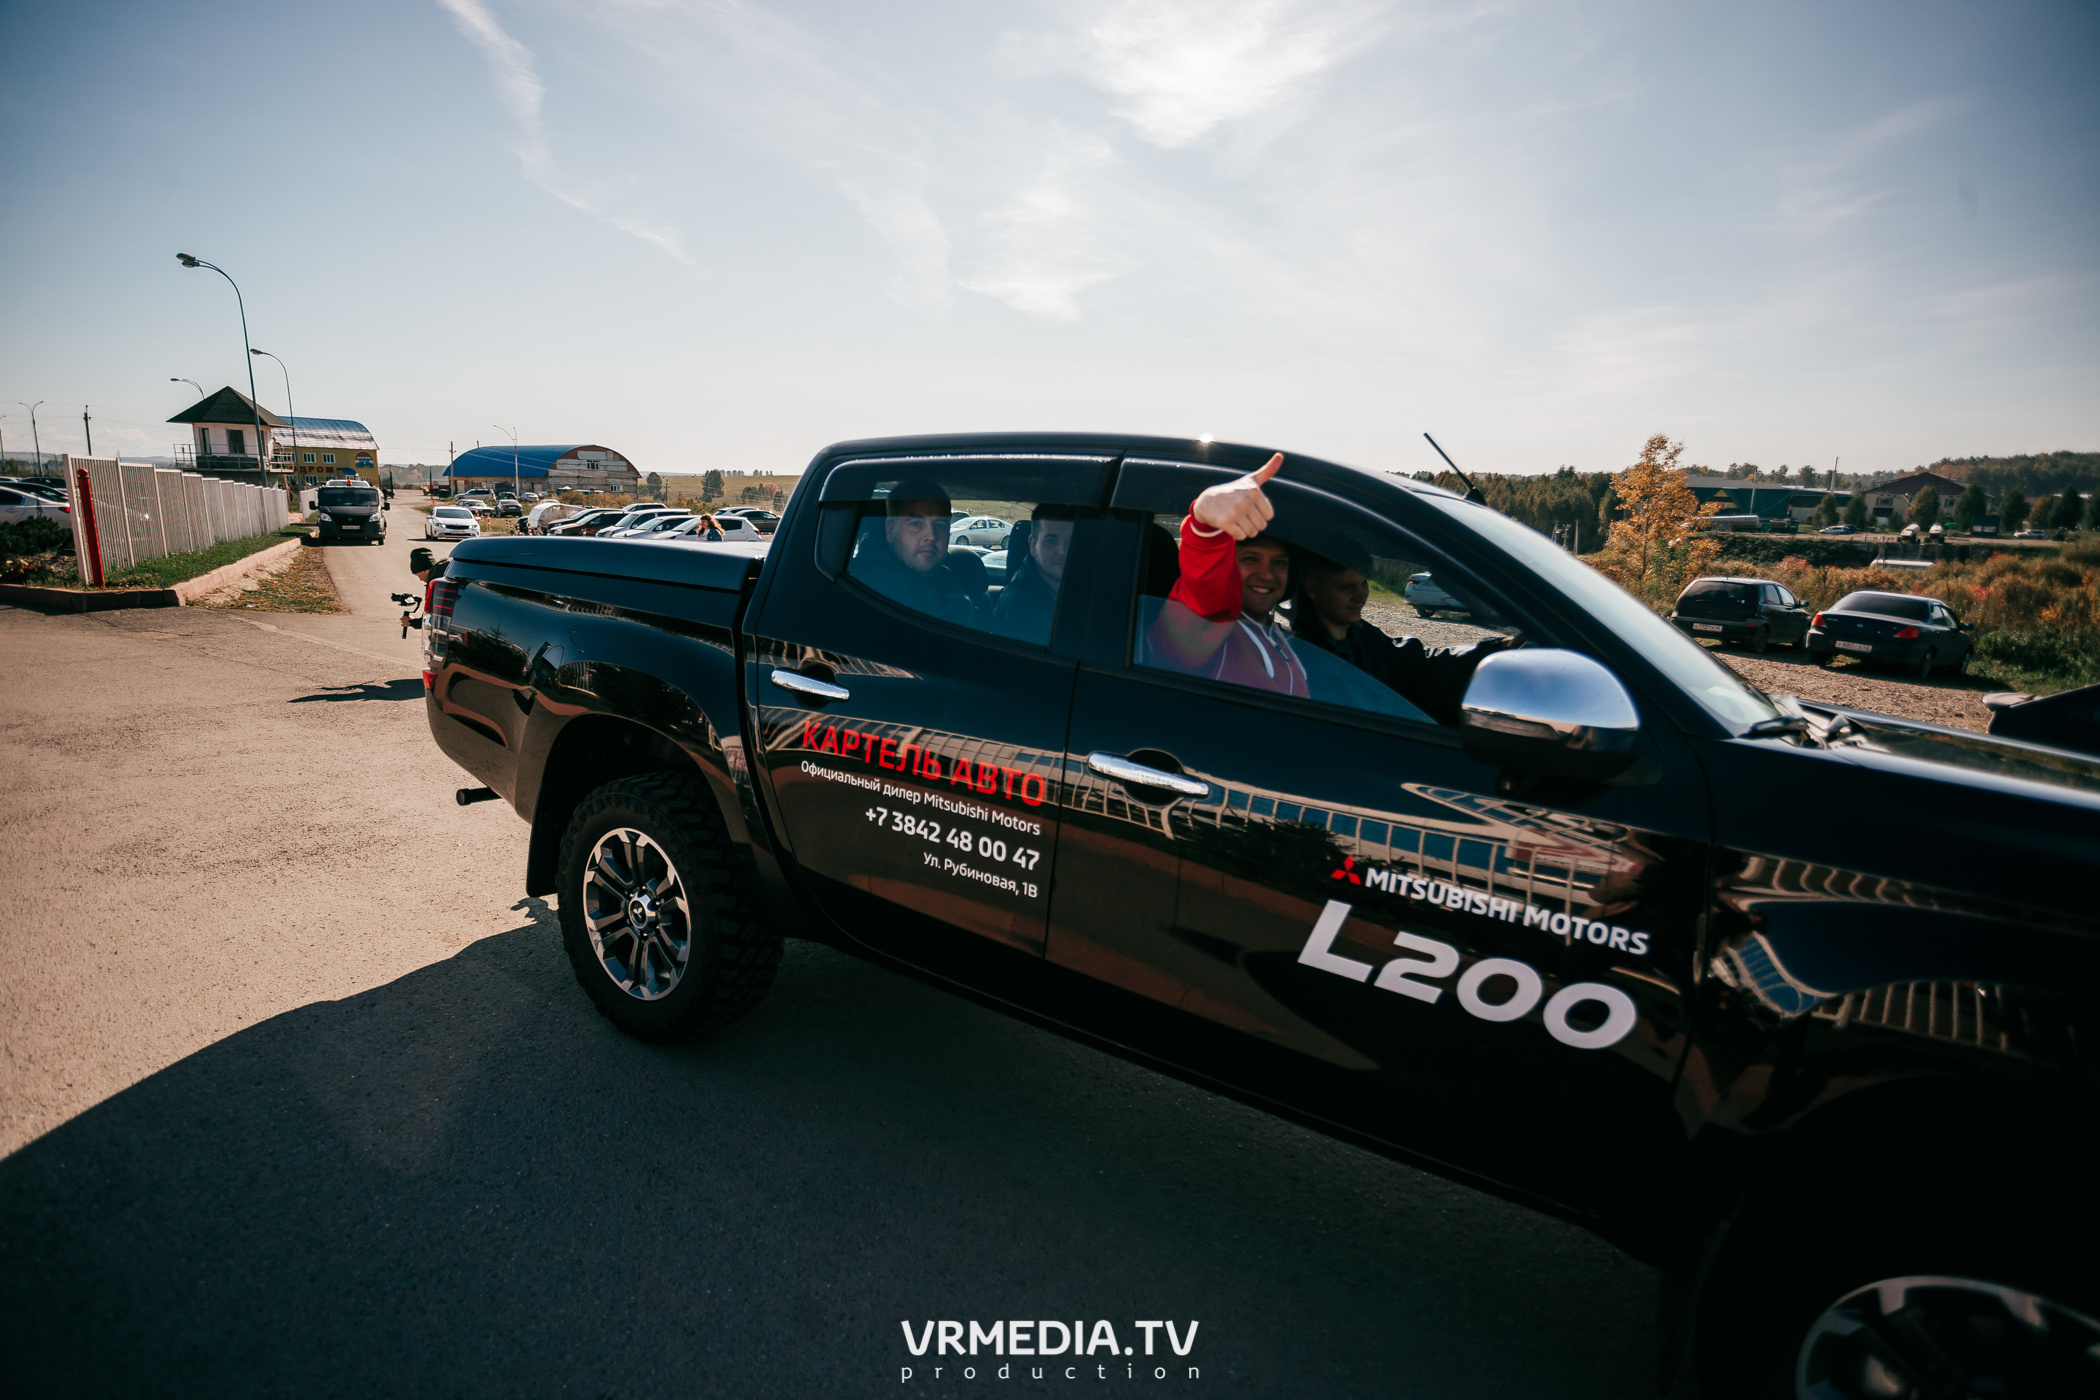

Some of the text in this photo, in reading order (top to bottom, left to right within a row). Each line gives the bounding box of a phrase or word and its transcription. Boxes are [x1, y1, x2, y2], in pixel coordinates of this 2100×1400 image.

[801, 760, 1041, 836] Официальный дилер Mitsubishi Motors
[802, 720, 1046, 807] КАРТЕЛЬ АВТО
[865, 807, 1040, 871] +7 3842 48 00 47
[923, 852, 942, 869] Ул.
[944, 858, 1020, 896] Рубиновая,
[1365, 867, 1650, 956] MITSUBISHI MOTORS
[1297, 899, 1638, 1050] L200
